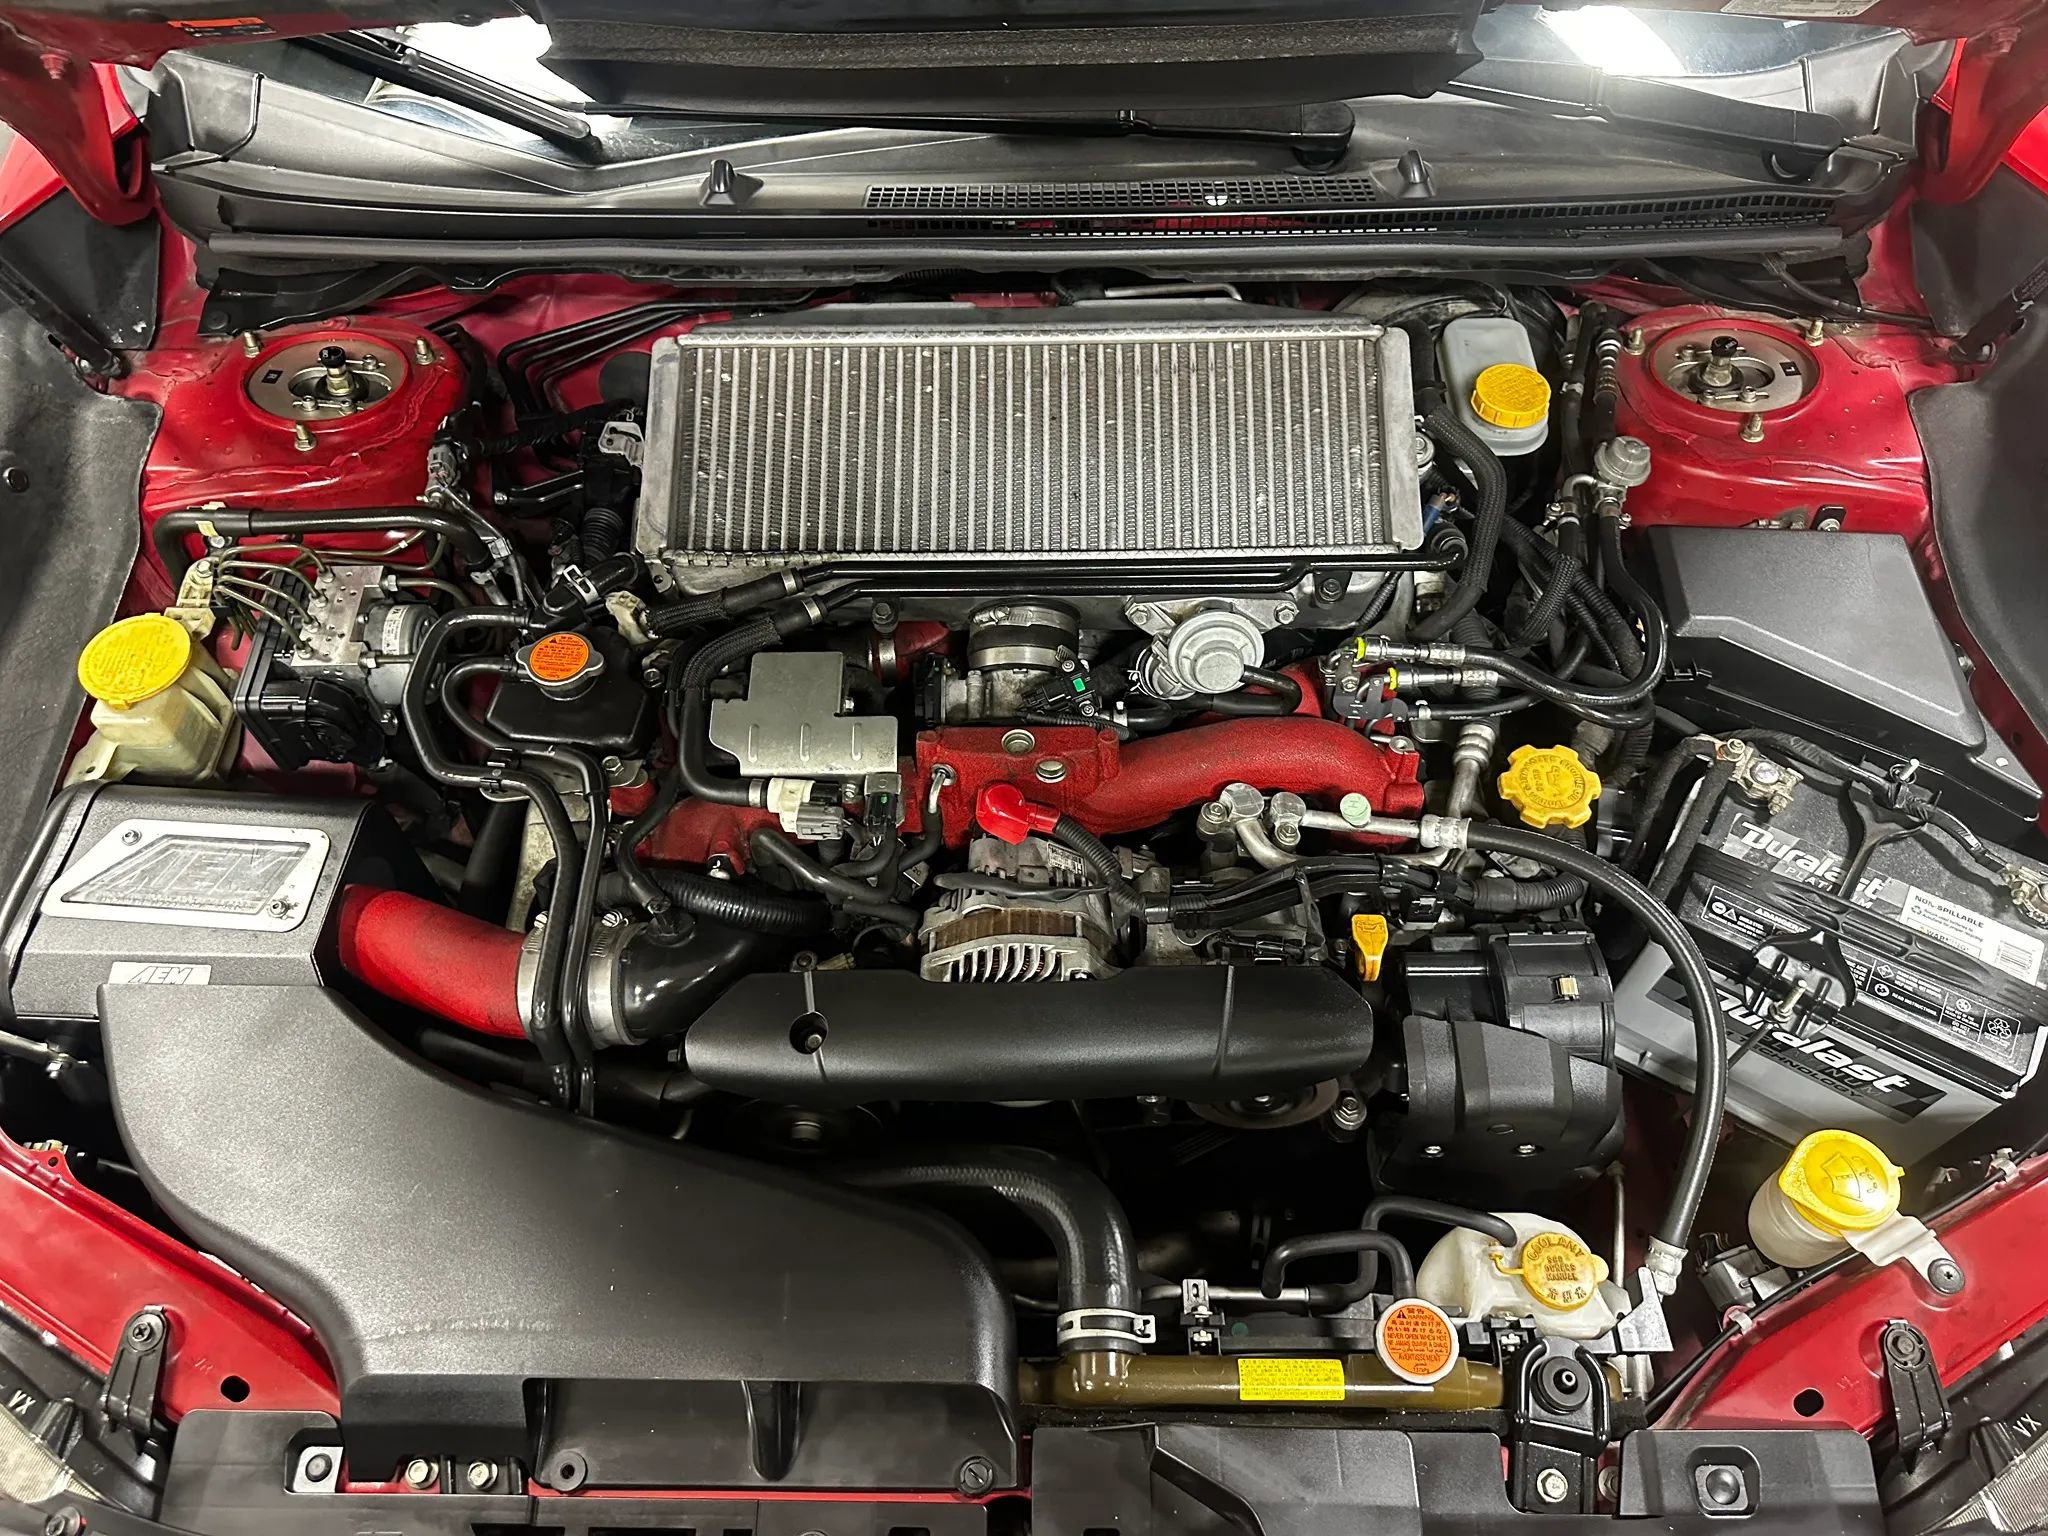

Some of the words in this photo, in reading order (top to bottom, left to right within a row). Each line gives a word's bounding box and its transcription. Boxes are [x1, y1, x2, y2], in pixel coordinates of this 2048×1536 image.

[1741, 821, 1888, 899] Duralat
[1784, 866, 1874, 909] PLATIM
[128, 966, 194, 985] AEM
[1763, 1034, 1885, 1097] PLANUM
